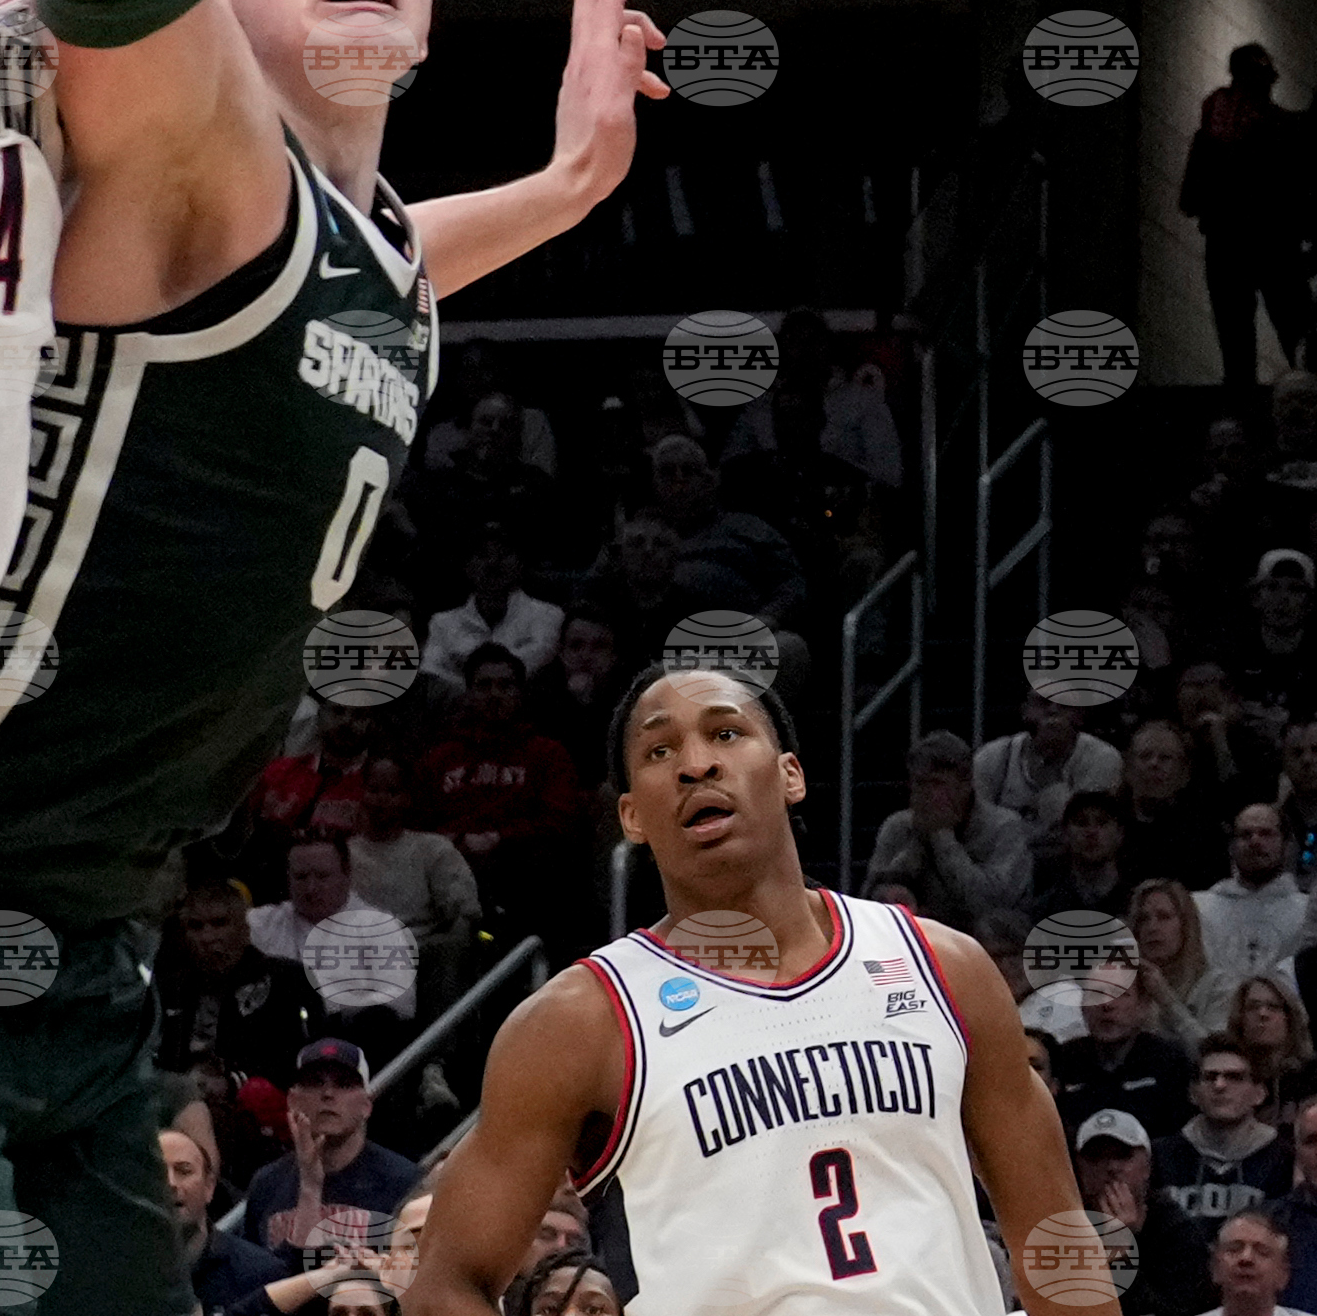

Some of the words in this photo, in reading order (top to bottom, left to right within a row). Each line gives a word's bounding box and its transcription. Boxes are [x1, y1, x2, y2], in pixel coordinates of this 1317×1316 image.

[310, 446, 390, 612] 0
[666, 988, 701, 1005] NCAA
[885, 1000, 928, 1014] EAST
[887, 990, 916, 1004] BIG
[683, 1040, 936, 1158] CONNECTICUT
[809, 1146, 878, 1281] 2
